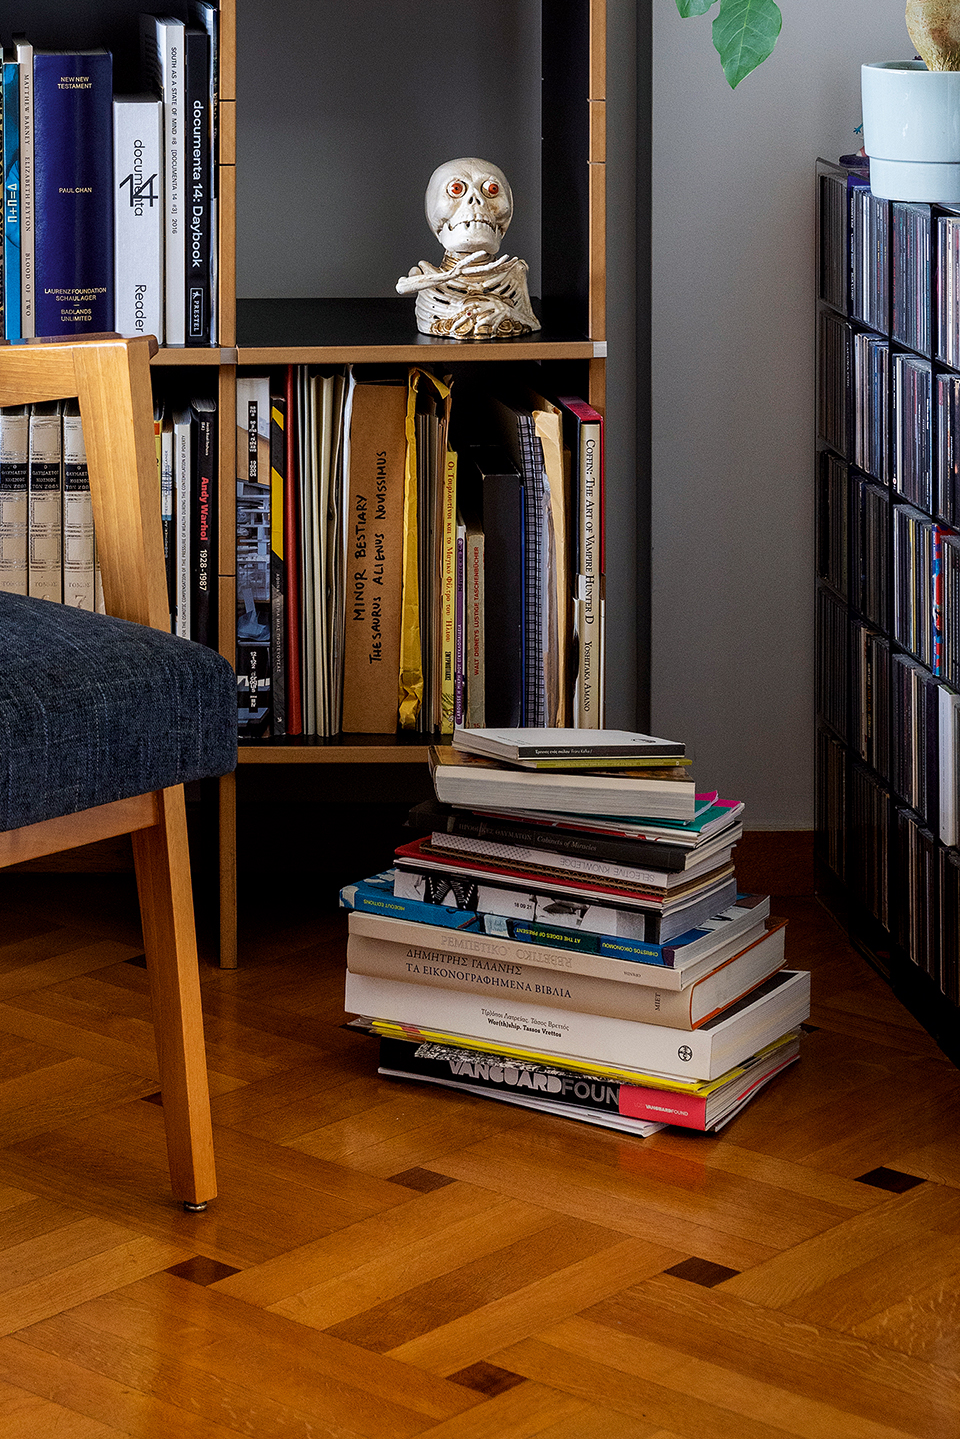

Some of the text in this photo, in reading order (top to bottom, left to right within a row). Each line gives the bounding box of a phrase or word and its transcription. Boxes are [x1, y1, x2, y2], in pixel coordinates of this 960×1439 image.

[134, 139, 144, 217] documenta
[192, 100, 203, 268] documenta 14: Daybook
[134, 283, 146, 333] Reader
[200, 477, 209, 541] Andy Warhol
[199, 550, 208, 591] 1928-1987
[353, 494, 367, 621] MINOR BESTIARY
[373, 534, 385, 584] ALIENUS
[370, 597, 382, 664] THESAURUS
[406, 948, 522, 976] ΔΗΜΗΤΡΗΣ ΓΑΛΑΝΗΣ
[406, 962, 572, 999] ΤΑ ΕΙΚΟΝΟΓΡΑΦΗΜΕΝΑ ΒΙΒΛΙΑ
